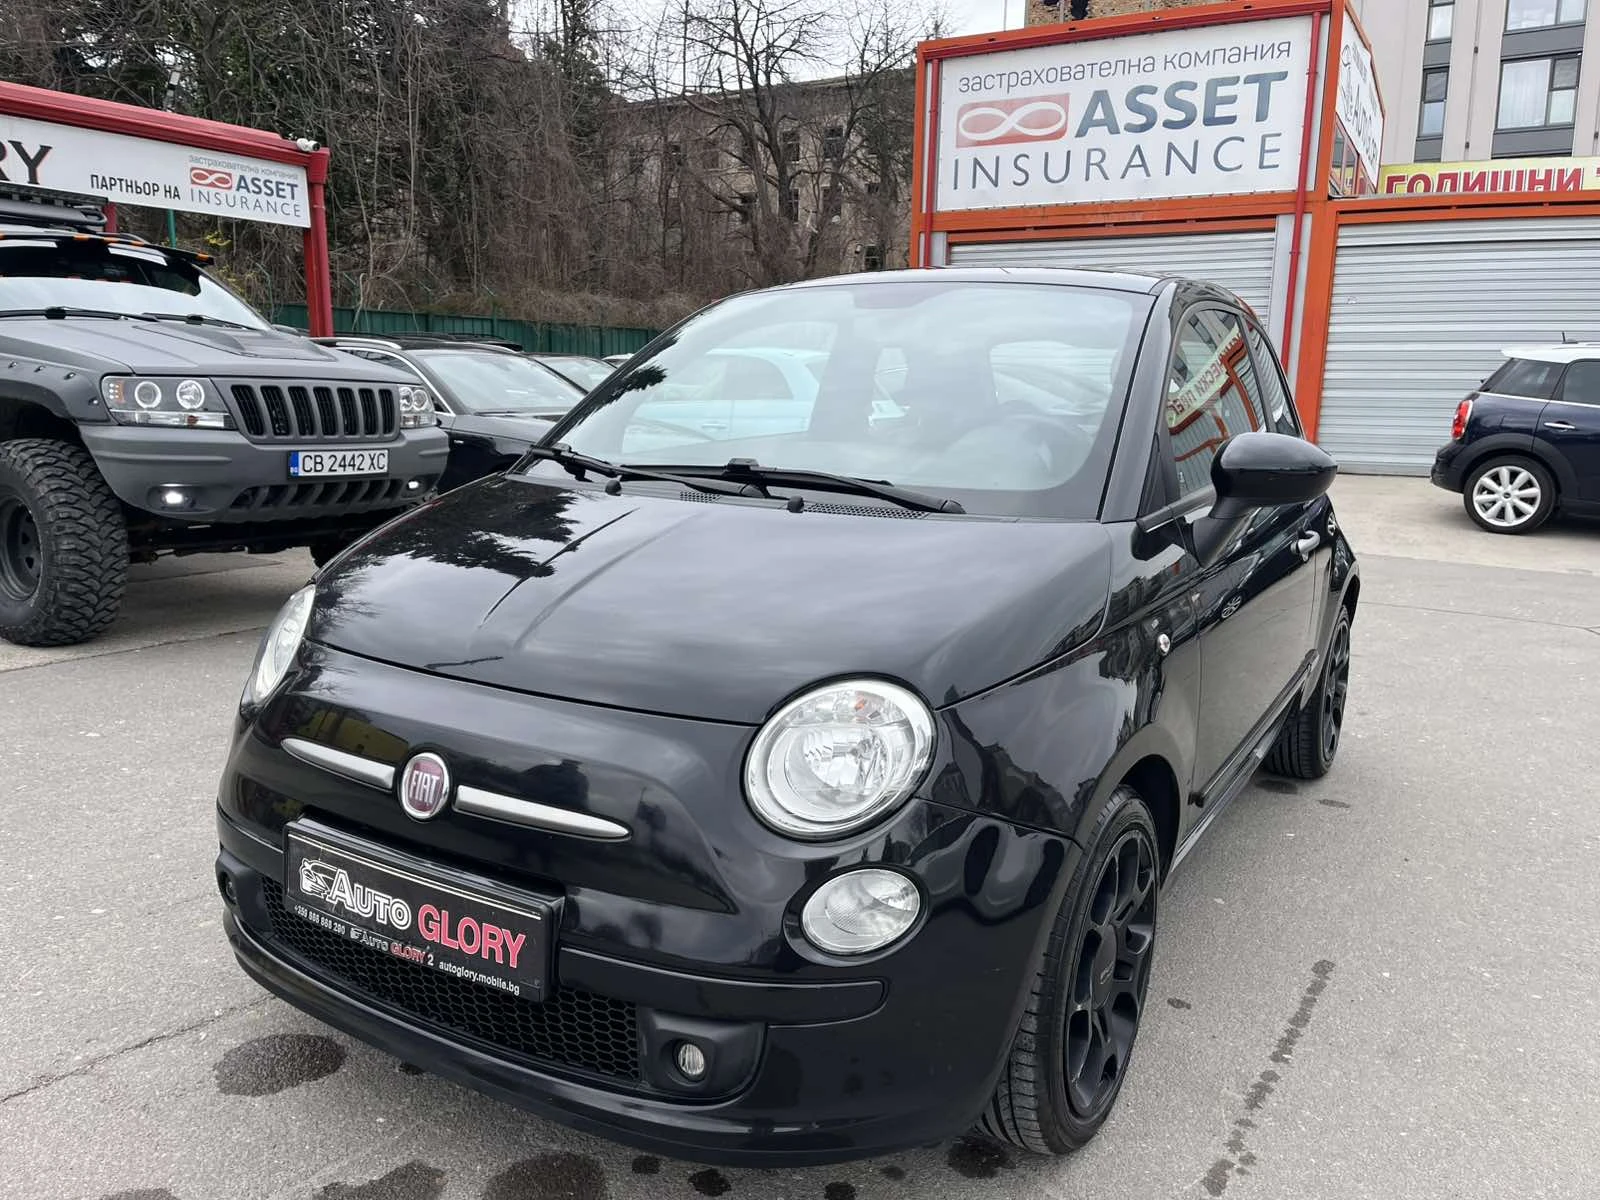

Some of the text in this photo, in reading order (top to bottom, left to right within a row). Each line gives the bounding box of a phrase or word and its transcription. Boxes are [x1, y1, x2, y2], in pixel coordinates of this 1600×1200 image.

[958, 41, 1292, 94] застрахователна компания
[1074, 71, 1289, 138] ASSET
[952, 132, 1283, 190] INSURANCE
[90, 174, 181, 200] ПАРТНЬОР НА
[190, 188, 302, 217] INSURANCE
[235, 175, 298, 200] ASSET
[328, 453, 365, 472] 2442
[409, 769, 441, 805] FIAT
[325, 869, 526, 968] AUTO GLORY
[390, 942, 426, 964] GLORY
[427, 954, 435, 966] 2
[439, 961, 520, 996] autoglory.mobile.bg
